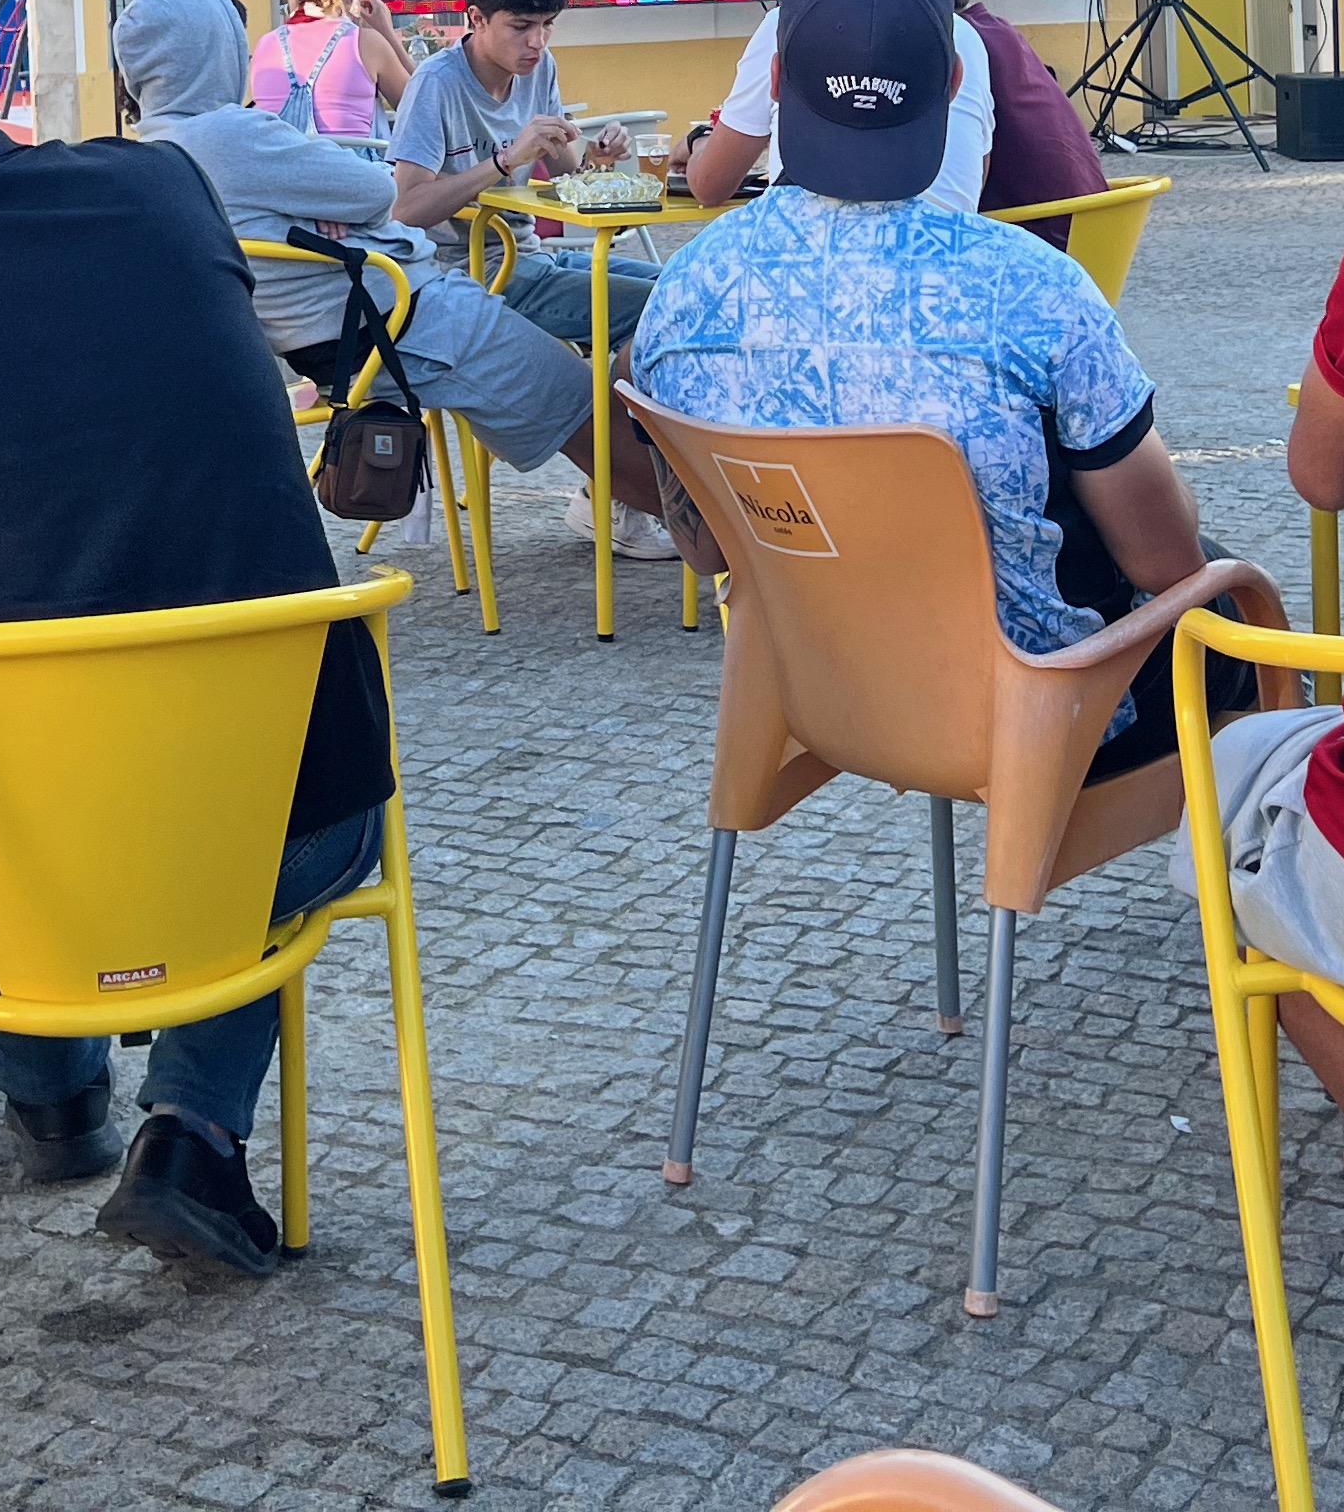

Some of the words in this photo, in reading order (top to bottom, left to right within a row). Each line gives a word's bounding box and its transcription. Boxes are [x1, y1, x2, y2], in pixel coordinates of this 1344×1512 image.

[825, 75, 907, 105] BILLABONG
[735, 491, 815, 525] Nicola
[102, 967, 159, 984] ARCALO
